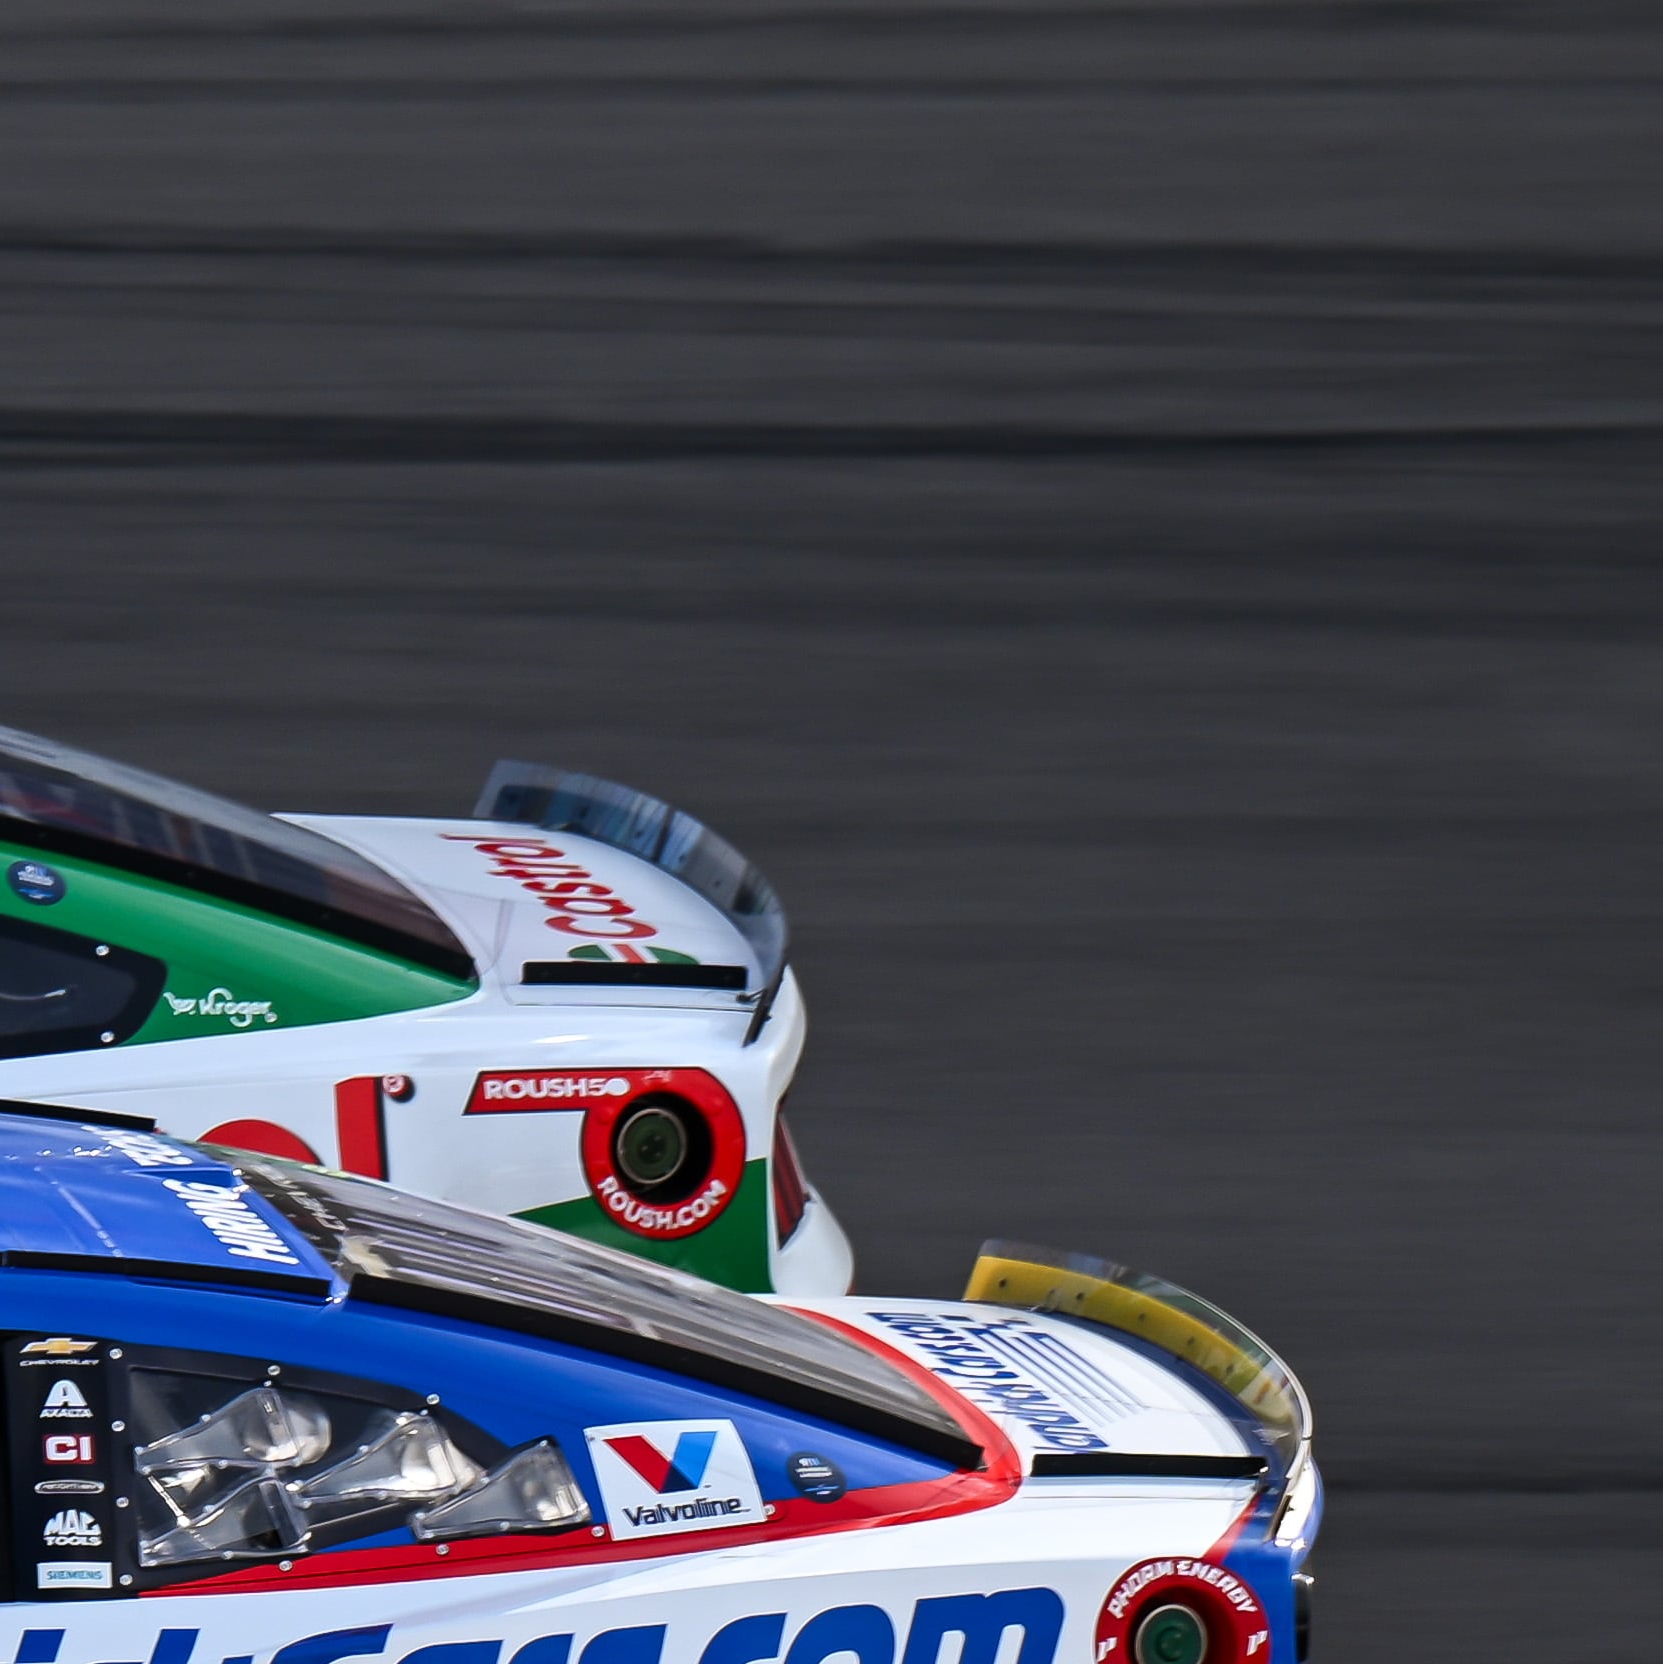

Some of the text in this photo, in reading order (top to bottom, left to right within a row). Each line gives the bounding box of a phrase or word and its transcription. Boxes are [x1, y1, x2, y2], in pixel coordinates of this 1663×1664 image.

[437, 833, 659, 940] Castrol
[198, 987, 273, 1027] Kroger
[598, 1175, 728, 1230] ROUSH.COM
[162, 1178, 300, 1265] HIRING
[43, 1509, 102, 1536] MAC
[624, 1498, 741, 1526] Valvoline
[43, 1536, 103, 1547] TOOLS
[46, 1570, 103, 1580] SIEMENS
